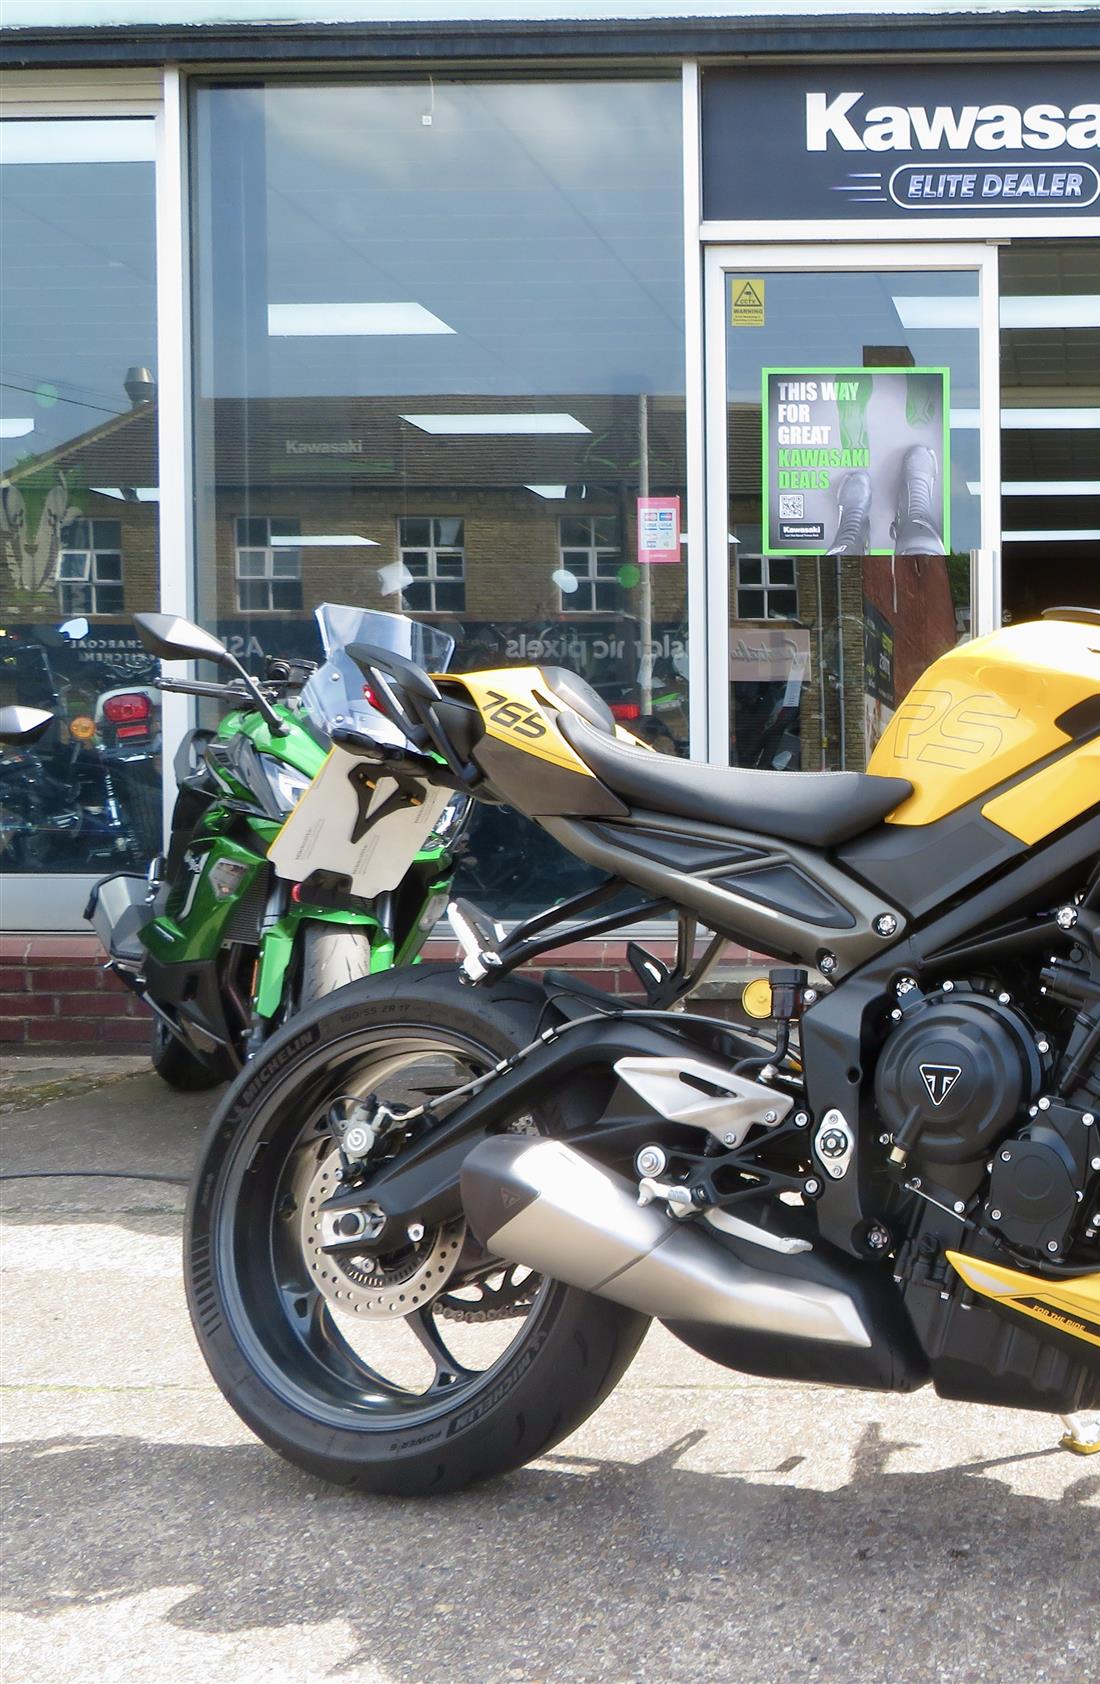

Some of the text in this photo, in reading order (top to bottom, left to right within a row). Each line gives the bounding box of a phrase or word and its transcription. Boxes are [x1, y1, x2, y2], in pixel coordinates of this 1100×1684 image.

[907, 173, 1082, 198] ELITE DEALER
[777, 382, 859, 401] THIS WAY
[777, 404, 810, 423] FOR
[777, 425, 831, 445] GREAT
[286, 440, 363, 454] Kawasaki
[777, 448, 870, 468] KAWASAKI
[777, 470, 831, 490] DEALS
[783, 526, 821, 534] Kawasaki
[482, 690, 547, 739] 765
[893, 689, 1021, 771] RS
[243, 1030, 315, 1104] MICHELIN
[1032, 1304, 1087, 1330] FOR THE RIDE
[455, 1353, 532, 1432] MICHELIN
